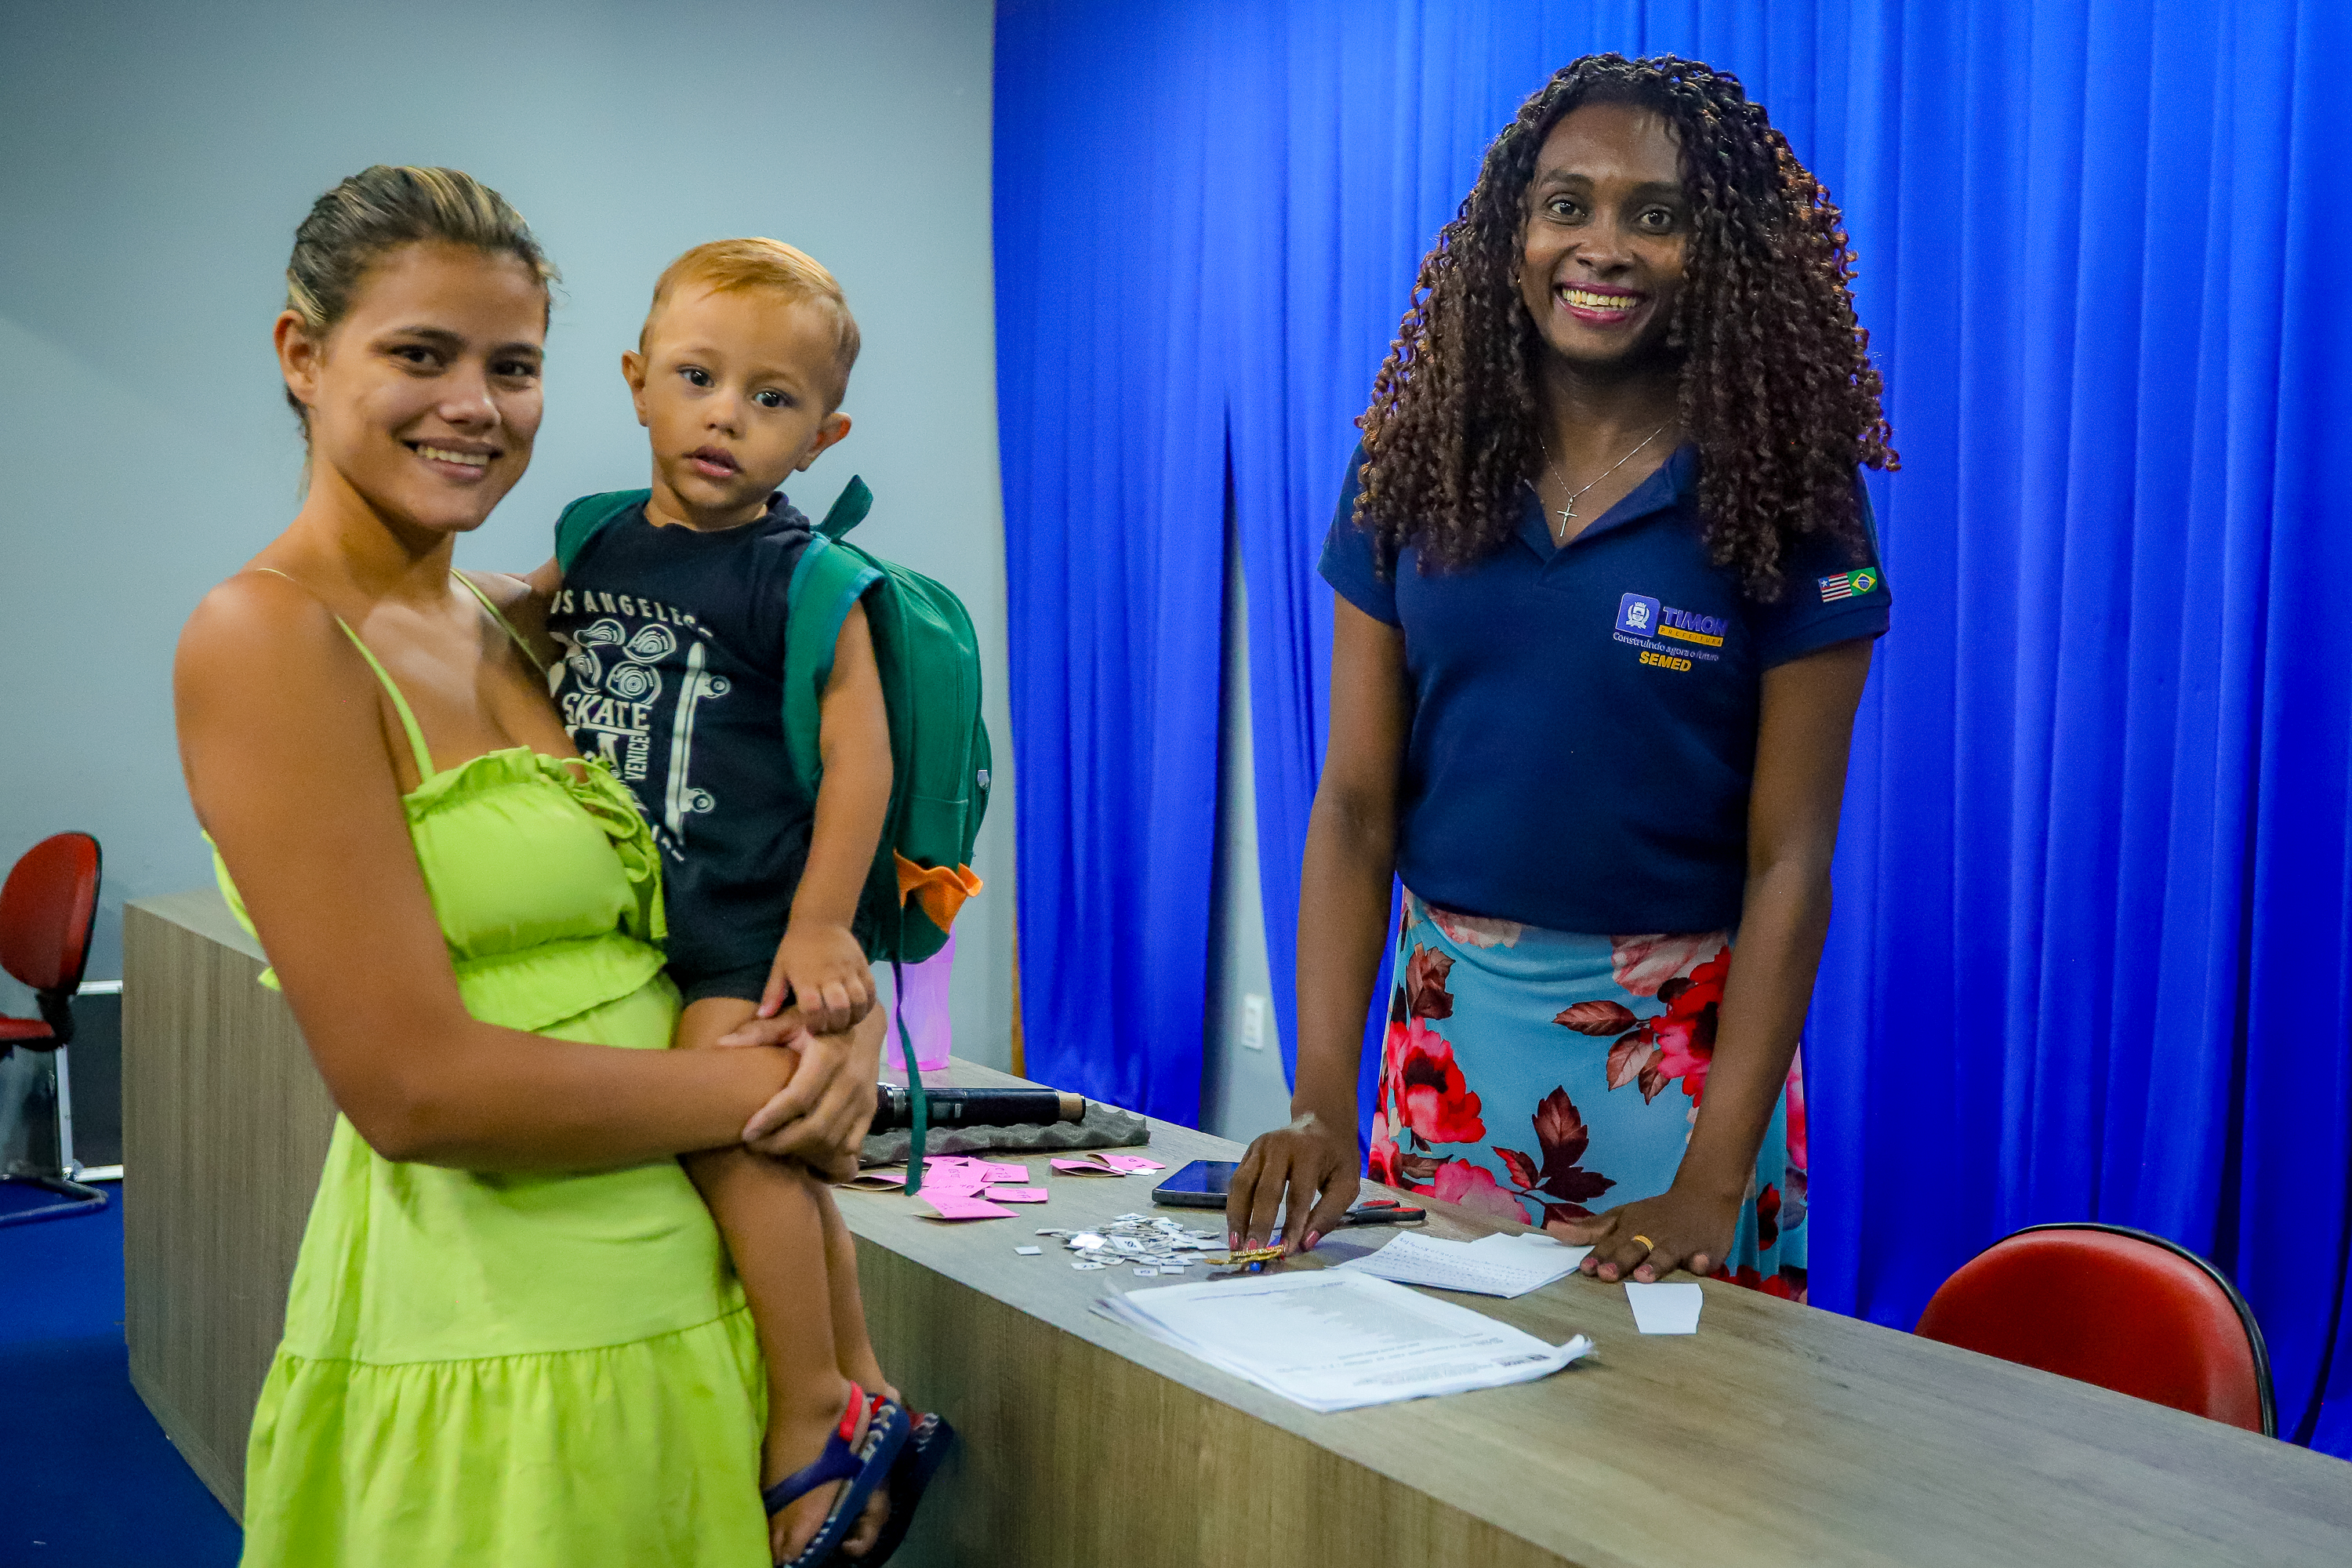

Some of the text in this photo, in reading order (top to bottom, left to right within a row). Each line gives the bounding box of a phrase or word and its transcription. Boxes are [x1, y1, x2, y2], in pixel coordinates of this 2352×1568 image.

[1663, 606, 1729, 637] TIMON
[1613, 631, 1666, 652] Construindo
[1666, 647, 1689, 658] agora
[1661, 628, 1722, 645] PREFEITURA
[1639, 651, 1692, 672] SEMED
[562, 692, 652, 731] SKATE
[624, 735, 651, 780] VENICE
